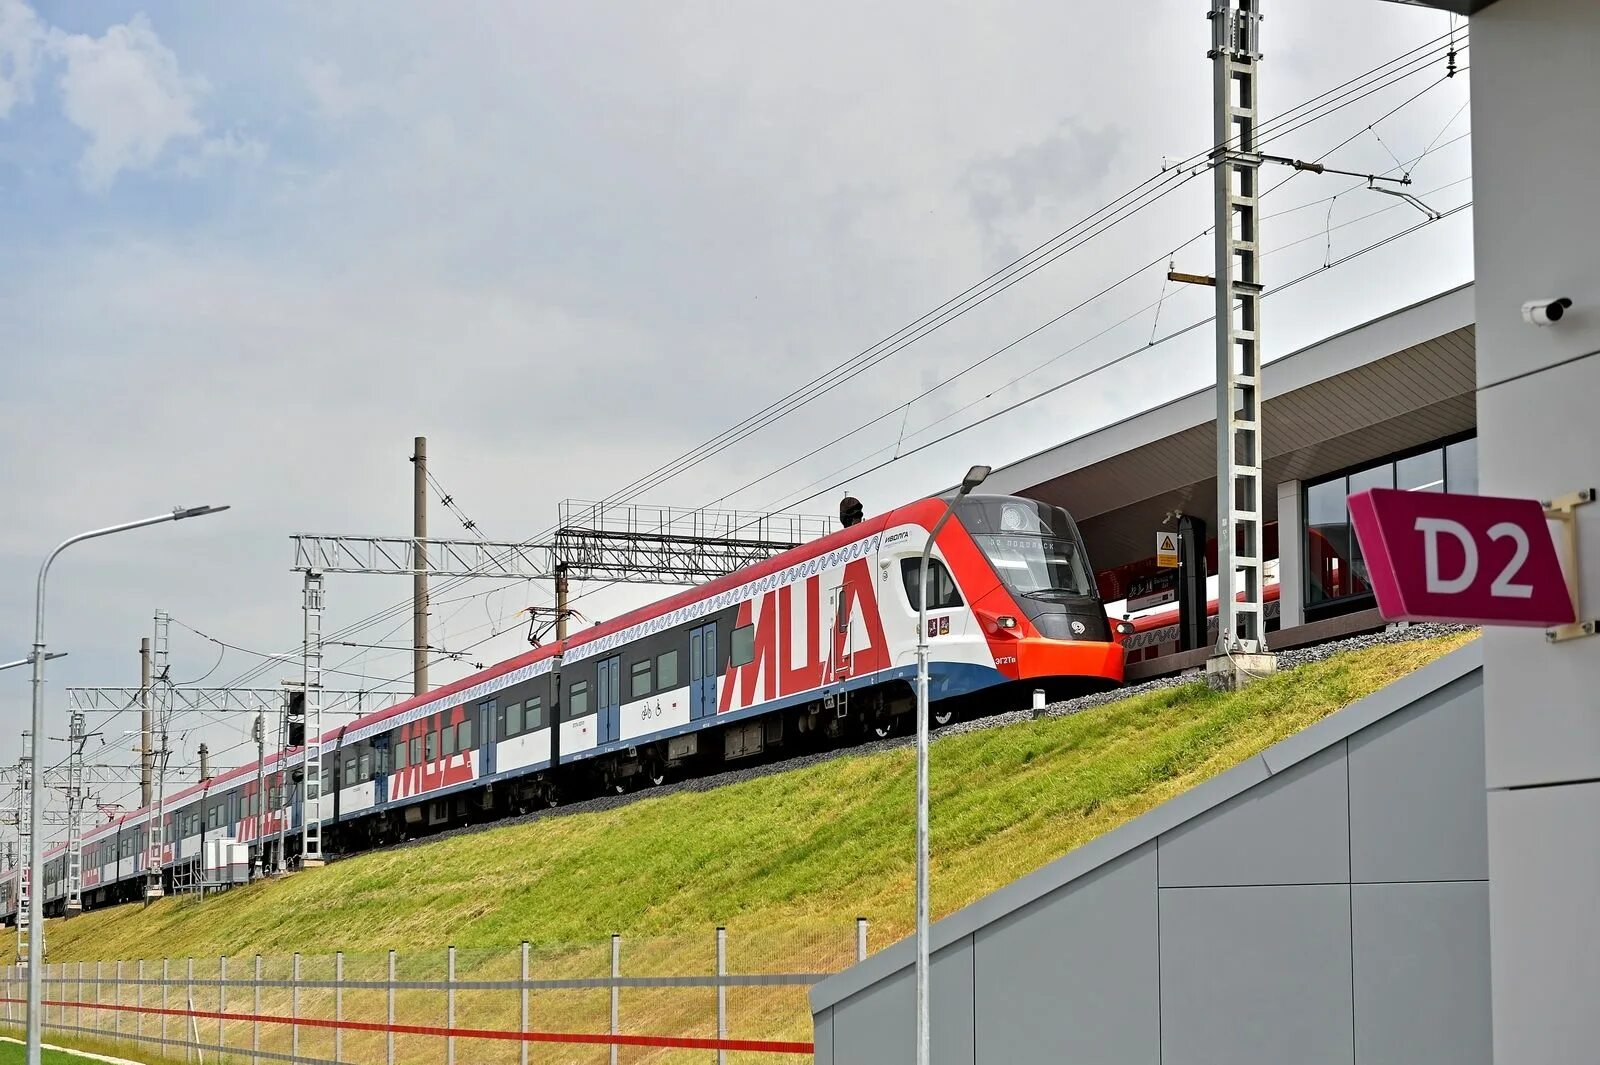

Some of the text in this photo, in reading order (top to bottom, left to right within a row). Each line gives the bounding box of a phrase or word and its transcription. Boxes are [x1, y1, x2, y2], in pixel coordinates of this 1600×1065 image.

[885, 531, 909, 543] ИВОЛГА
[1414, 516, 1534, 599] D2
[718, 557, 892, 713] МЦД
[392, 704, 473, 800] МЦД
